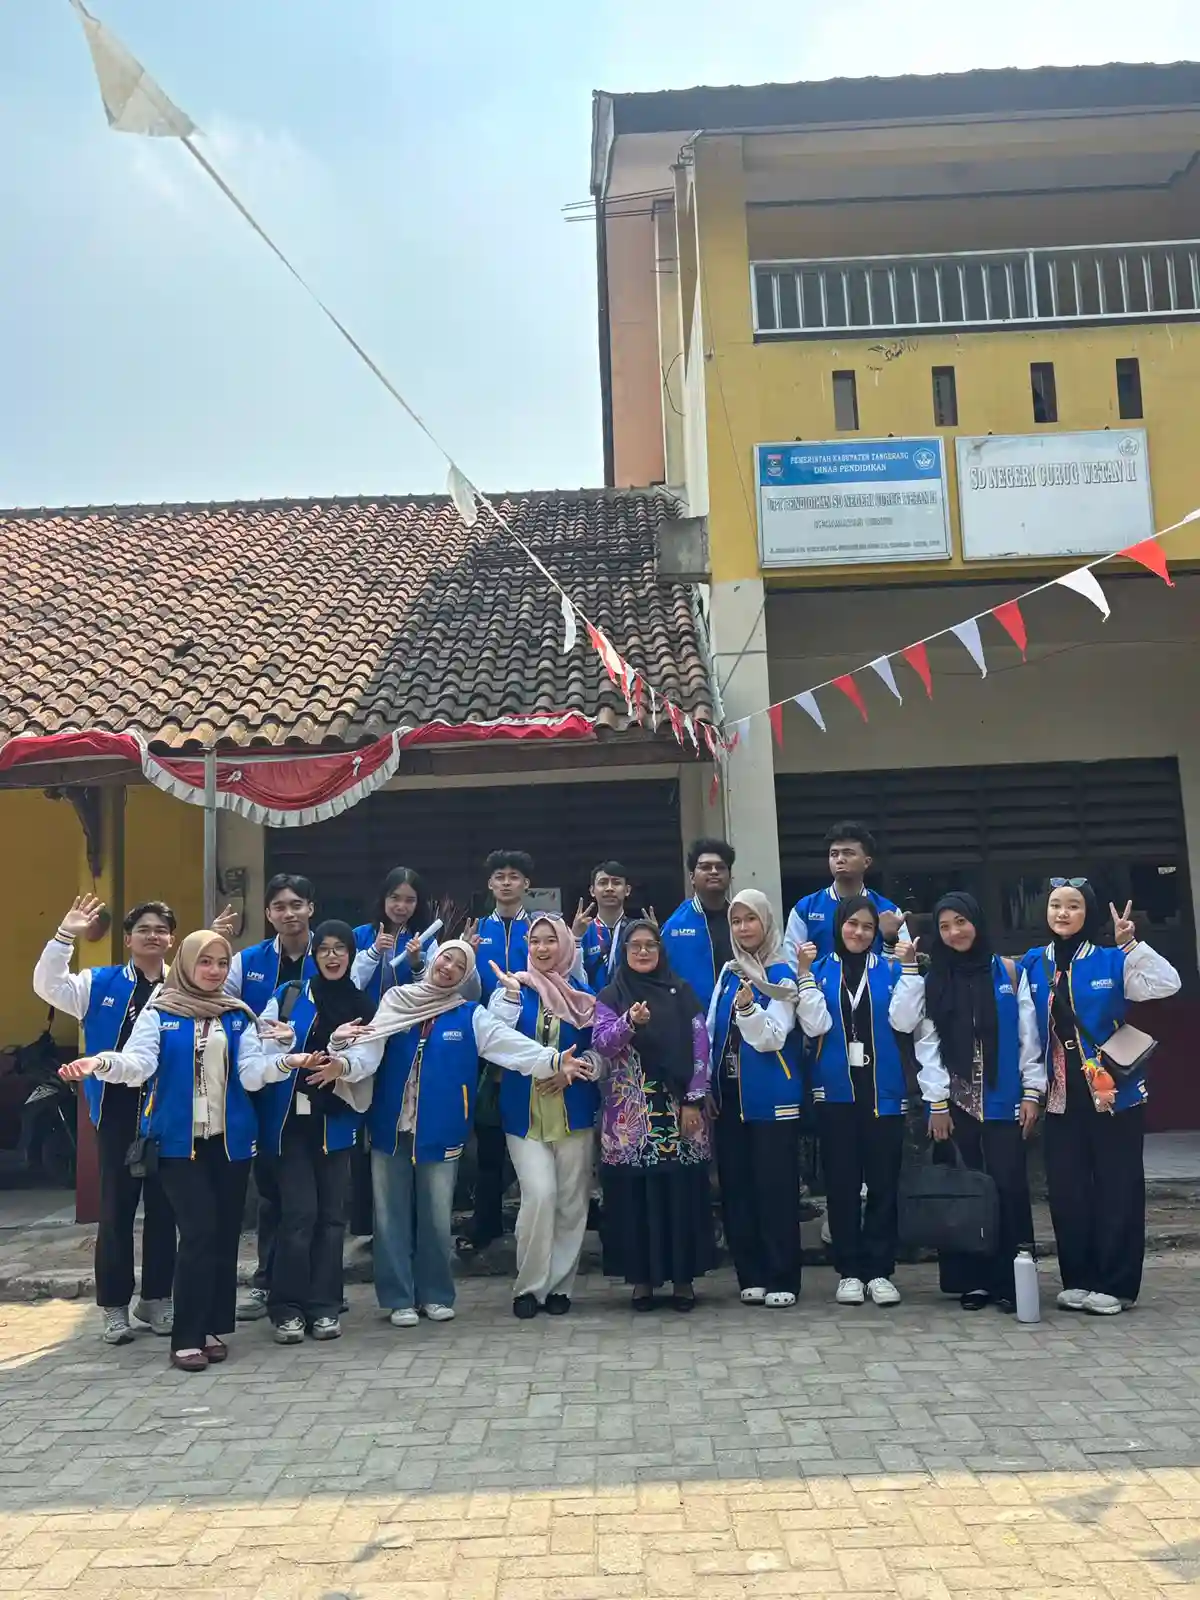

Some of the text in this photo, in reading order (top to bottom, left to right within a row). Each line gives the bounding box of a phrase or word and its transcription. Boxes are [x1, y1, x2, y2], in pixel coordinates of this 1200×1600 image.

[813, 463, 887, 475] DINAS PENDIDIKAN
[969, 459, 1137, 490] SD NEGERI CURUG WETAN II
[246, 971, 265, 980] LPPM
